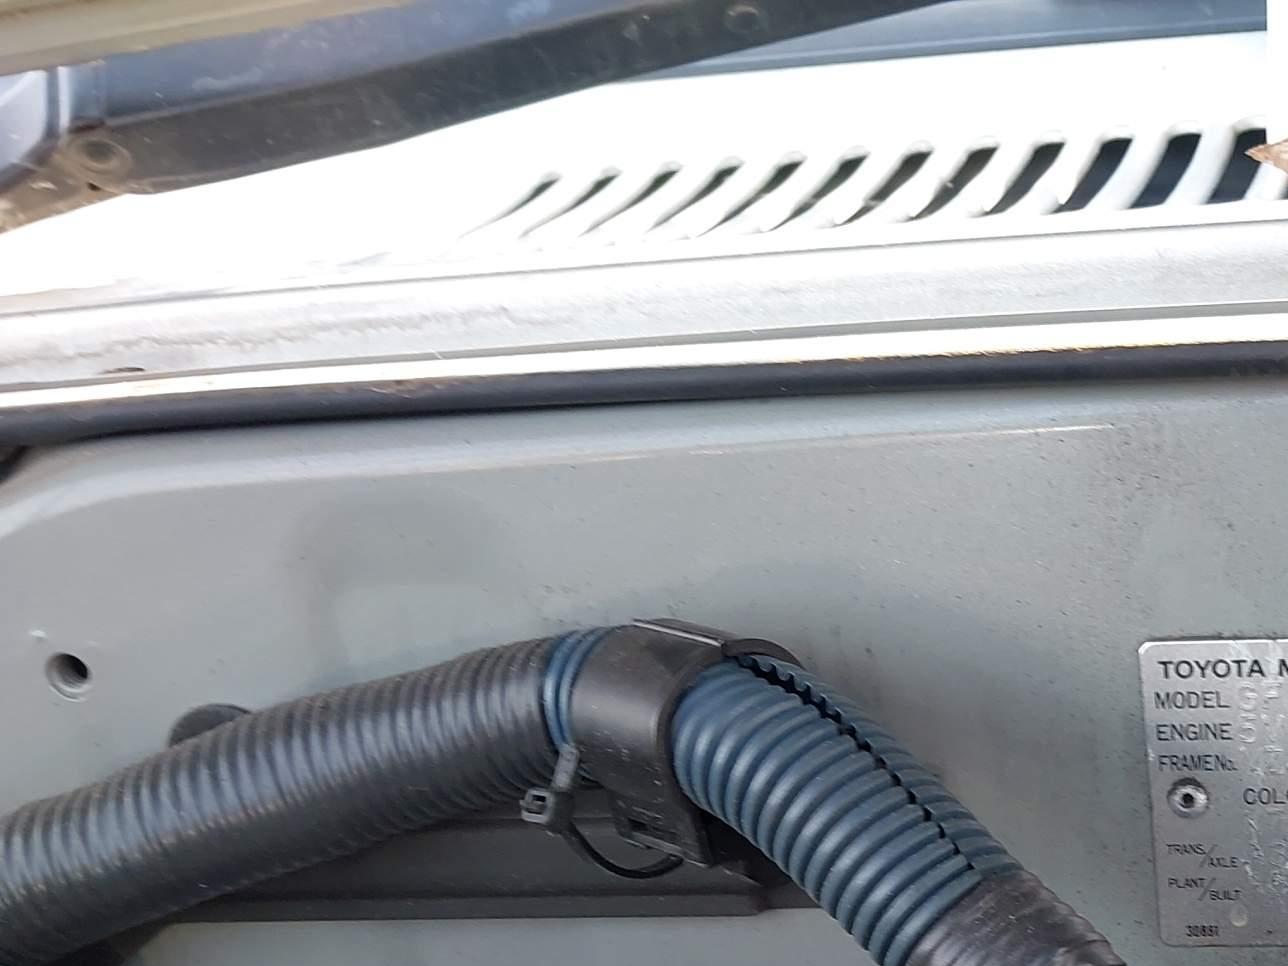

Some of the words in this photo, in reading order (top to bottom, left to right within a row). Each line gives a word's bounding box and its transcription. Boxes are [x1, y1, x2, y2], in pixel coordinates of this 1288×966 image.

[1158, 659, 1266, 679] TOYOTA
[1154, 690, 1230, 709] MODEL
[1156, 723, 1233, 741] ENGINE
